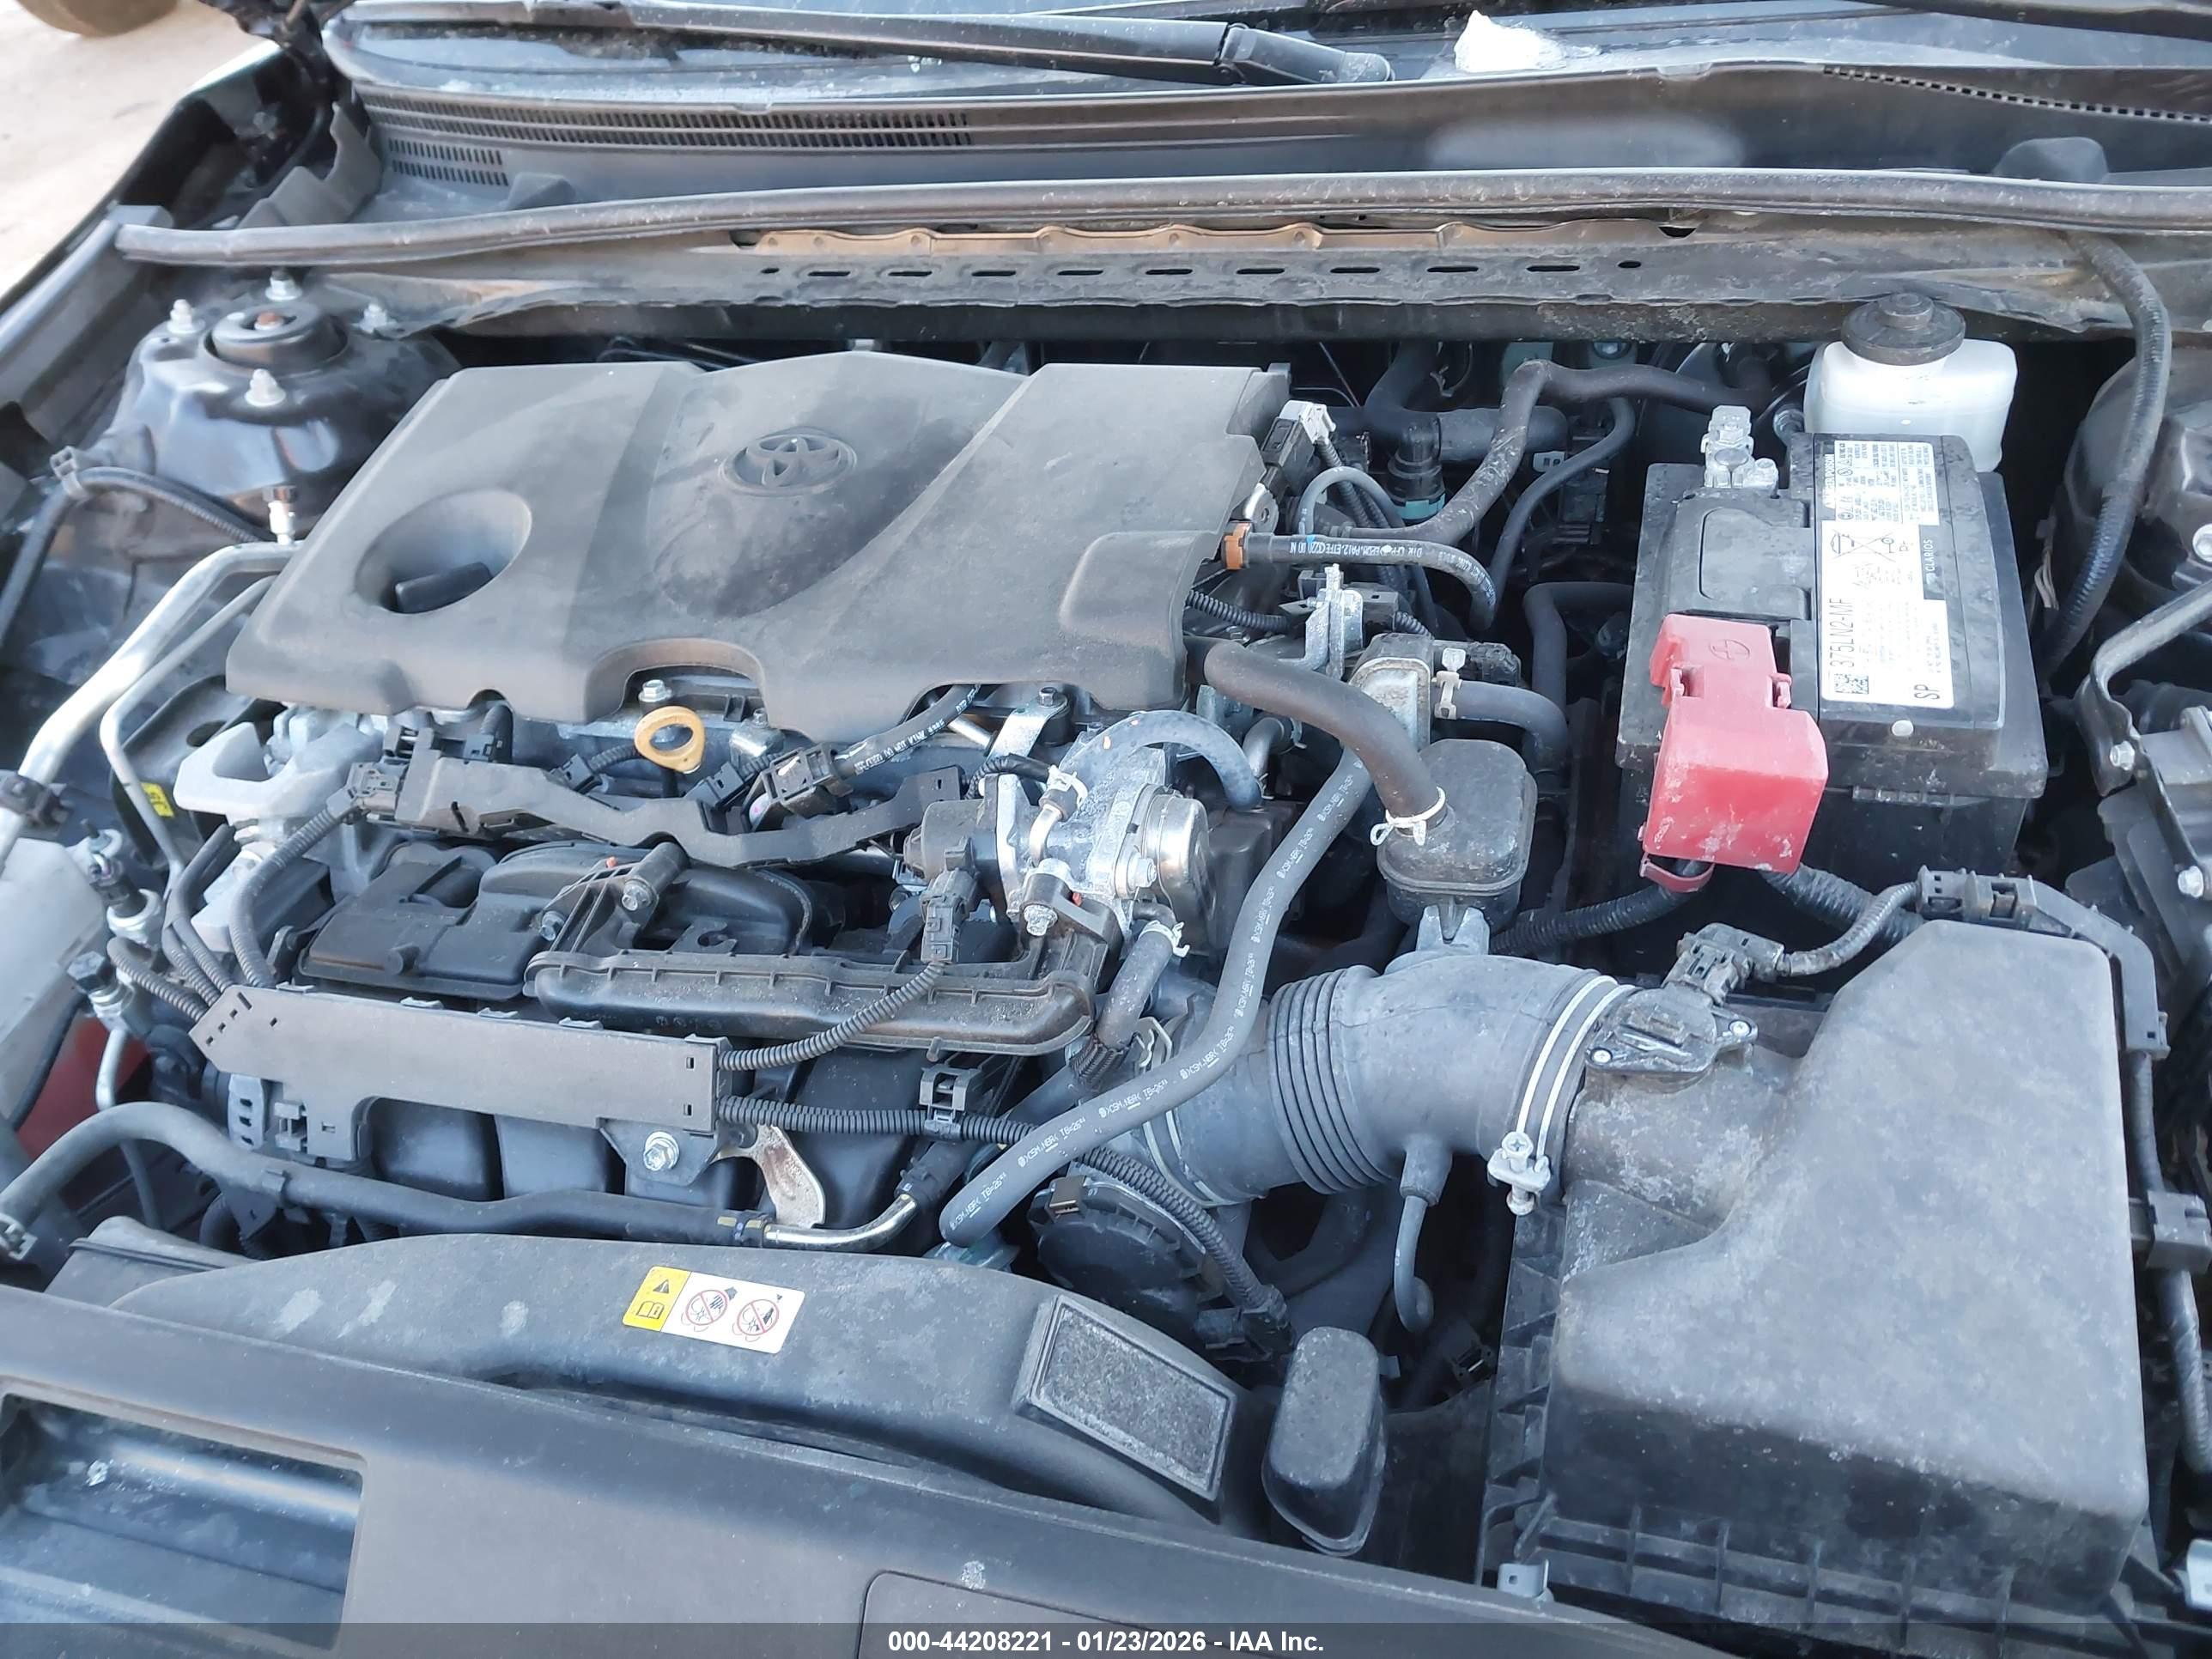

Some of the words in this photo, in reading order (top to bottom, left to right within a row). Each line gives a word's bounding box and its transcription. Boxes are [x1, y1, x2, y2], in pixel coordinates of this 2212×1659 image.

[1924, 538, 1936, 571] CLARIOS
[1829, 599, 1855, 667] 375LN2-MF
[1913, 684, 1941, 700] SP
